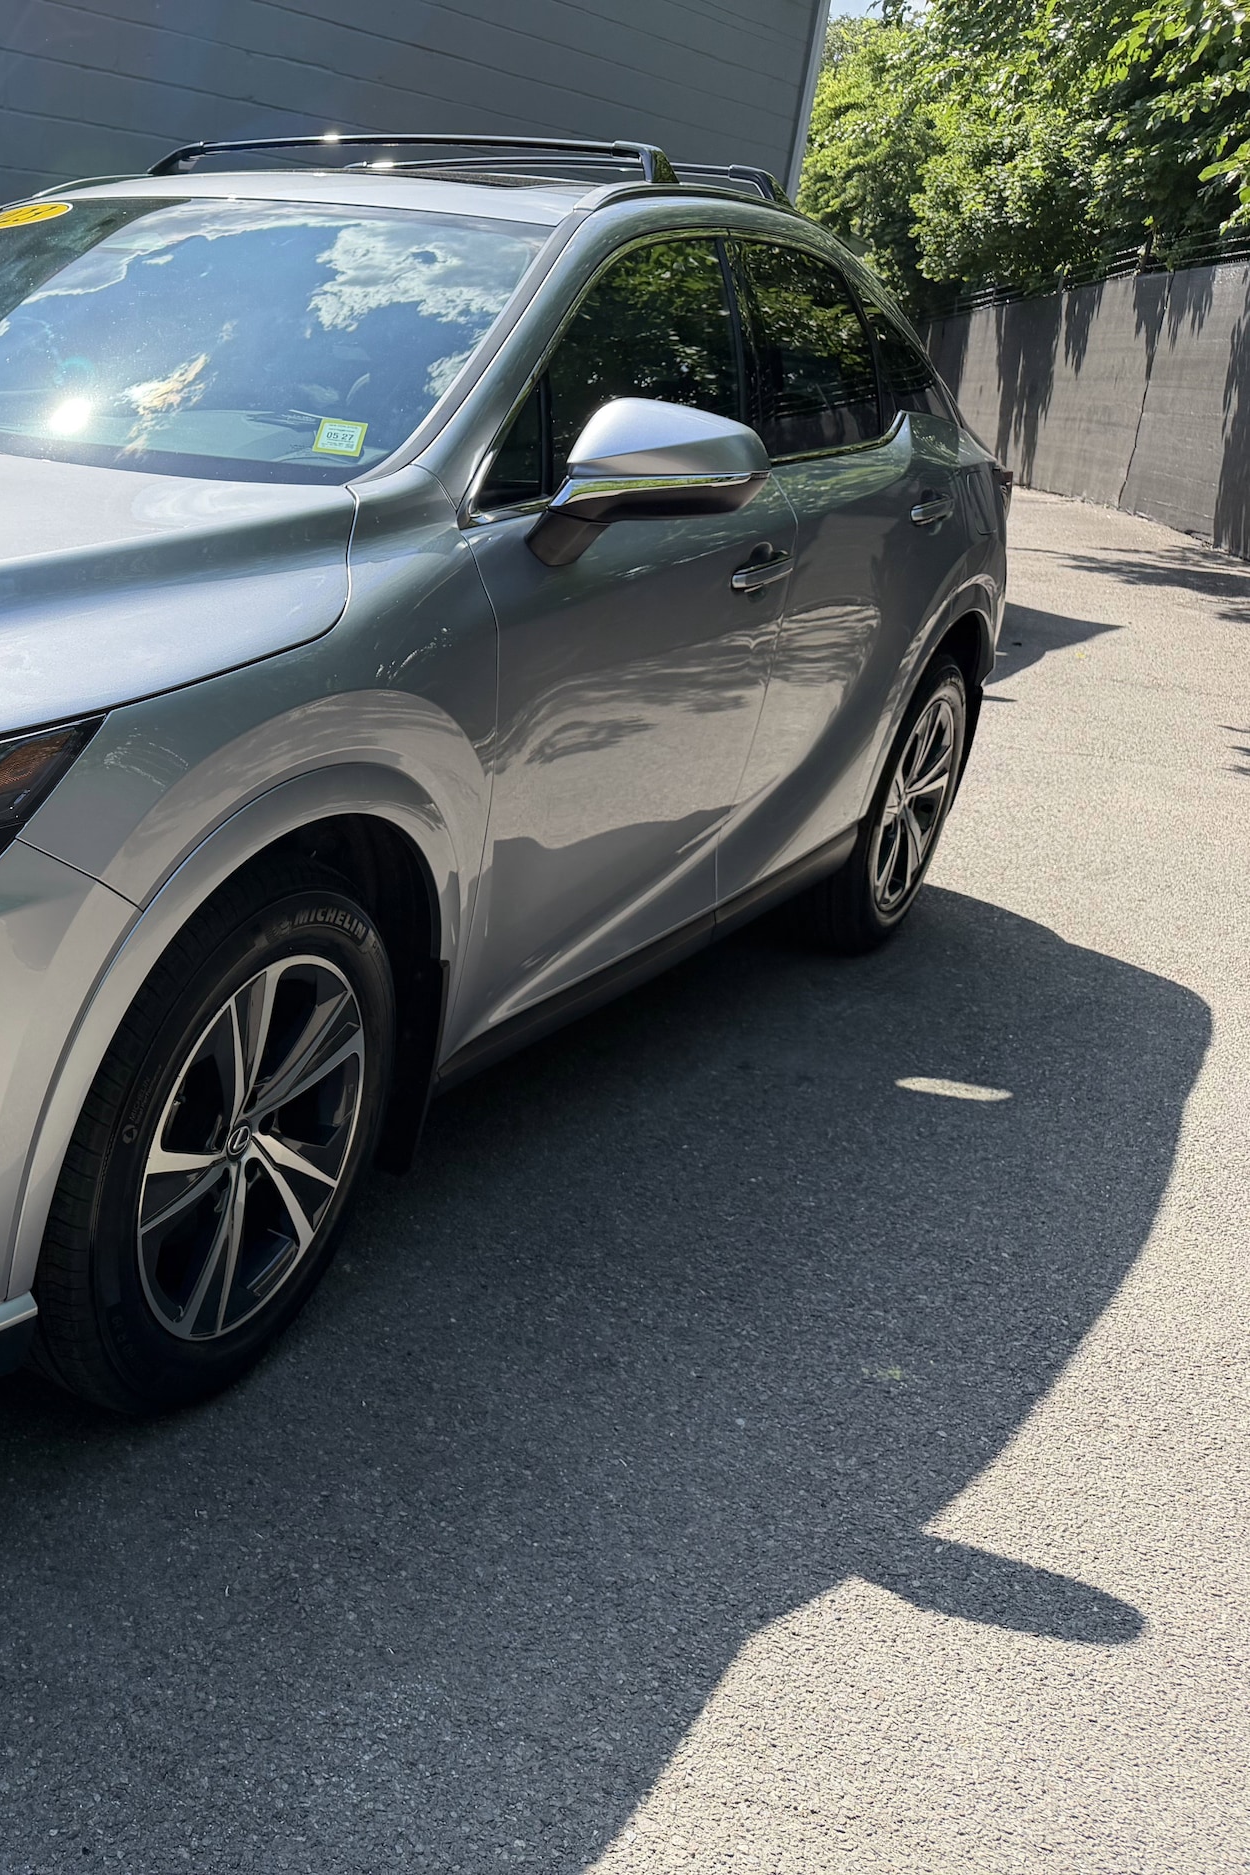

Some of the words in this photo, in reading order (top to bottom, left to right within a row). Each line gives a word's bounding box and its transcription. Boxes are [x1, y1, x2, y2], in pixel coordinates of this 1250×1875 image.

[326, 431, 339, 439] 05
[341, 433, 355, 441] 27
[293, 907, 367, 940] MICHELIN
